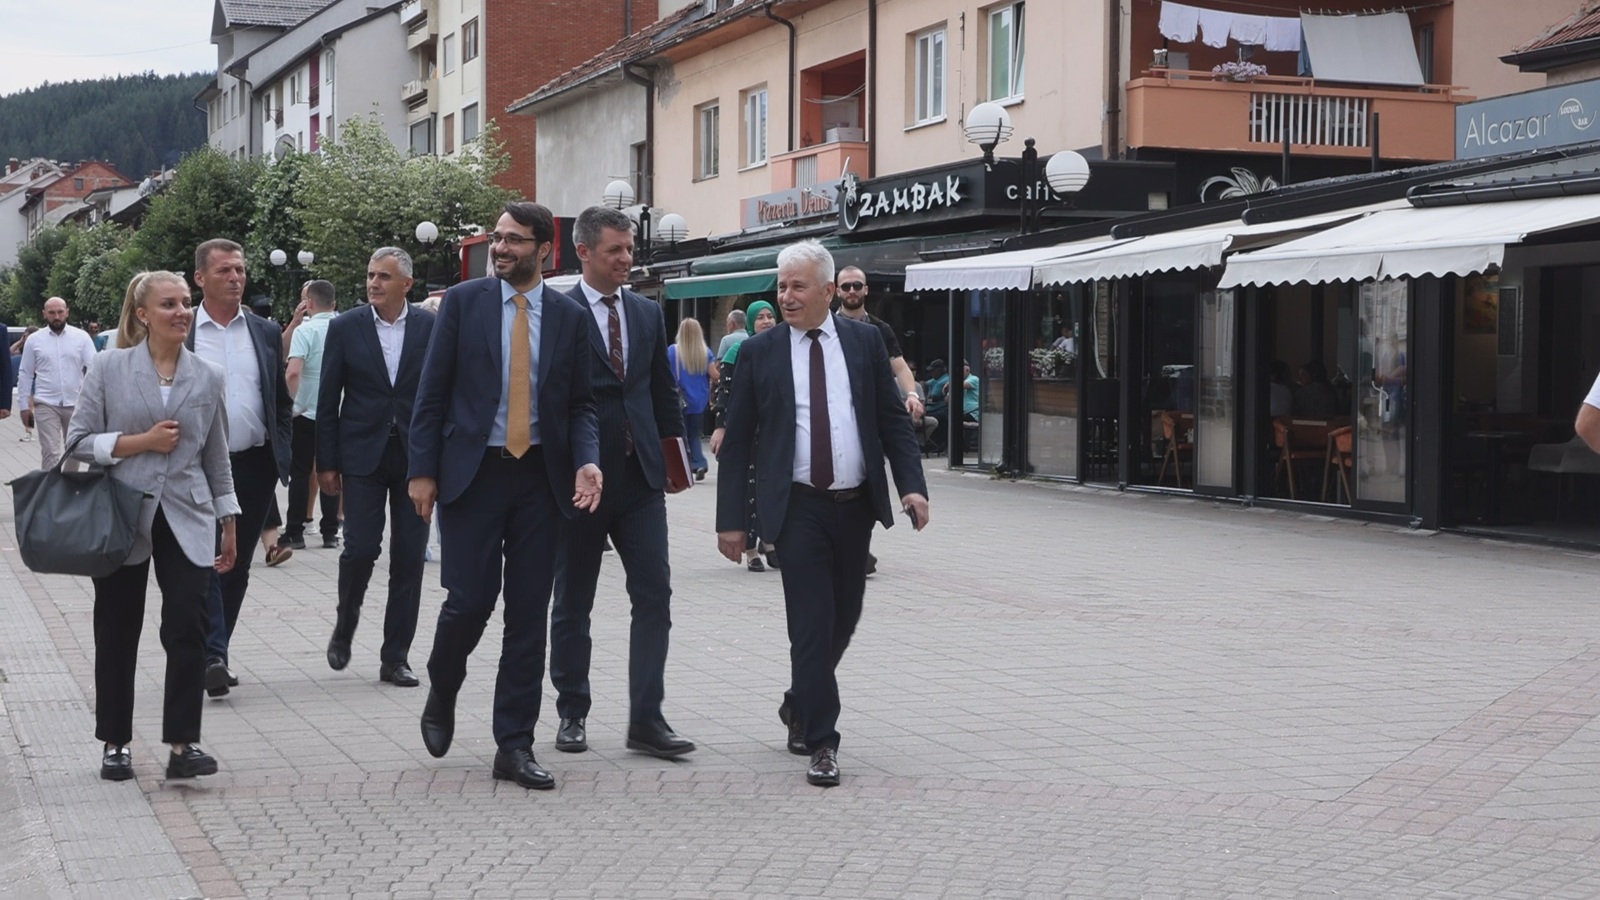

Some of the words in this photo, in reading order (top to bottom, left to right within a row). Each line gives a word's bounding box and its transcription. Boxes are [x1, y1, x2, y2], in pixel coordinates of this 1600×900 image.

[1464, 112, 1551, 148] Alcazar
[1578, 117, 1588, 126] BAR
[757, 197, 796, 222] Pizzeria
[859, 175, 961, 217] ZAMBAK
